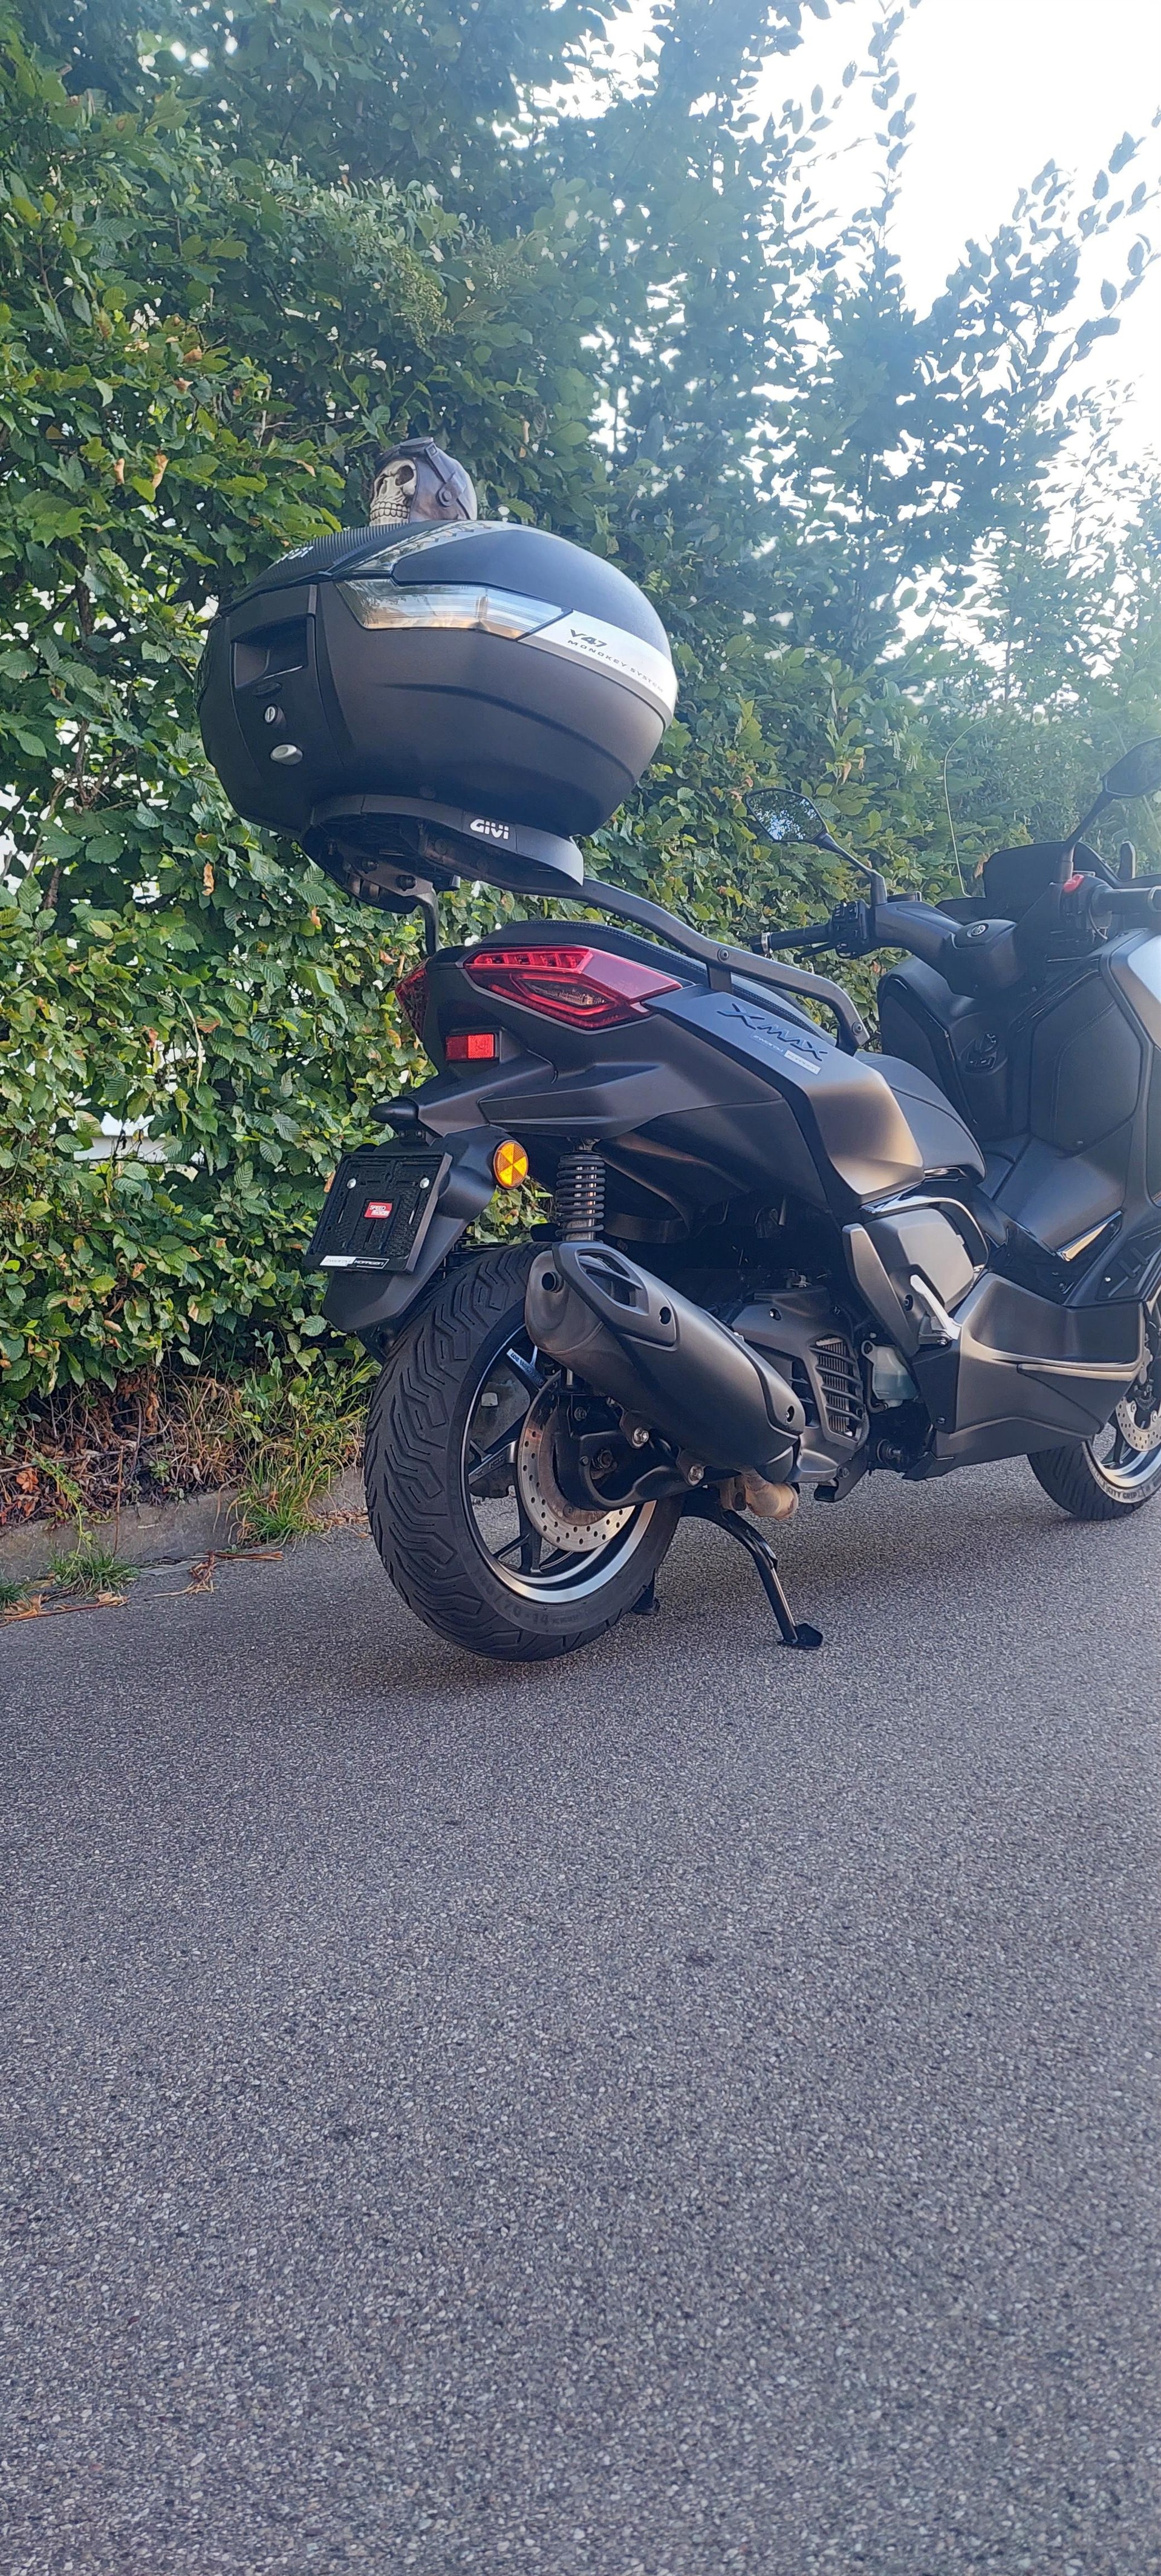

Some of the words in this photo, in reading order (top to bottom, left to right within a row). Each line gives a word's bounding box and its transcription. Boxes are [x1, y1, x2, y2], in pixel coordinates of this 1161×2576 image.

[570, 628, 608, 648] V47
[567, 640, 627, 667] MONOKEY
[630, 667, 664, 693] SYSTEM
[470, 818, 509, 840] GIVI
